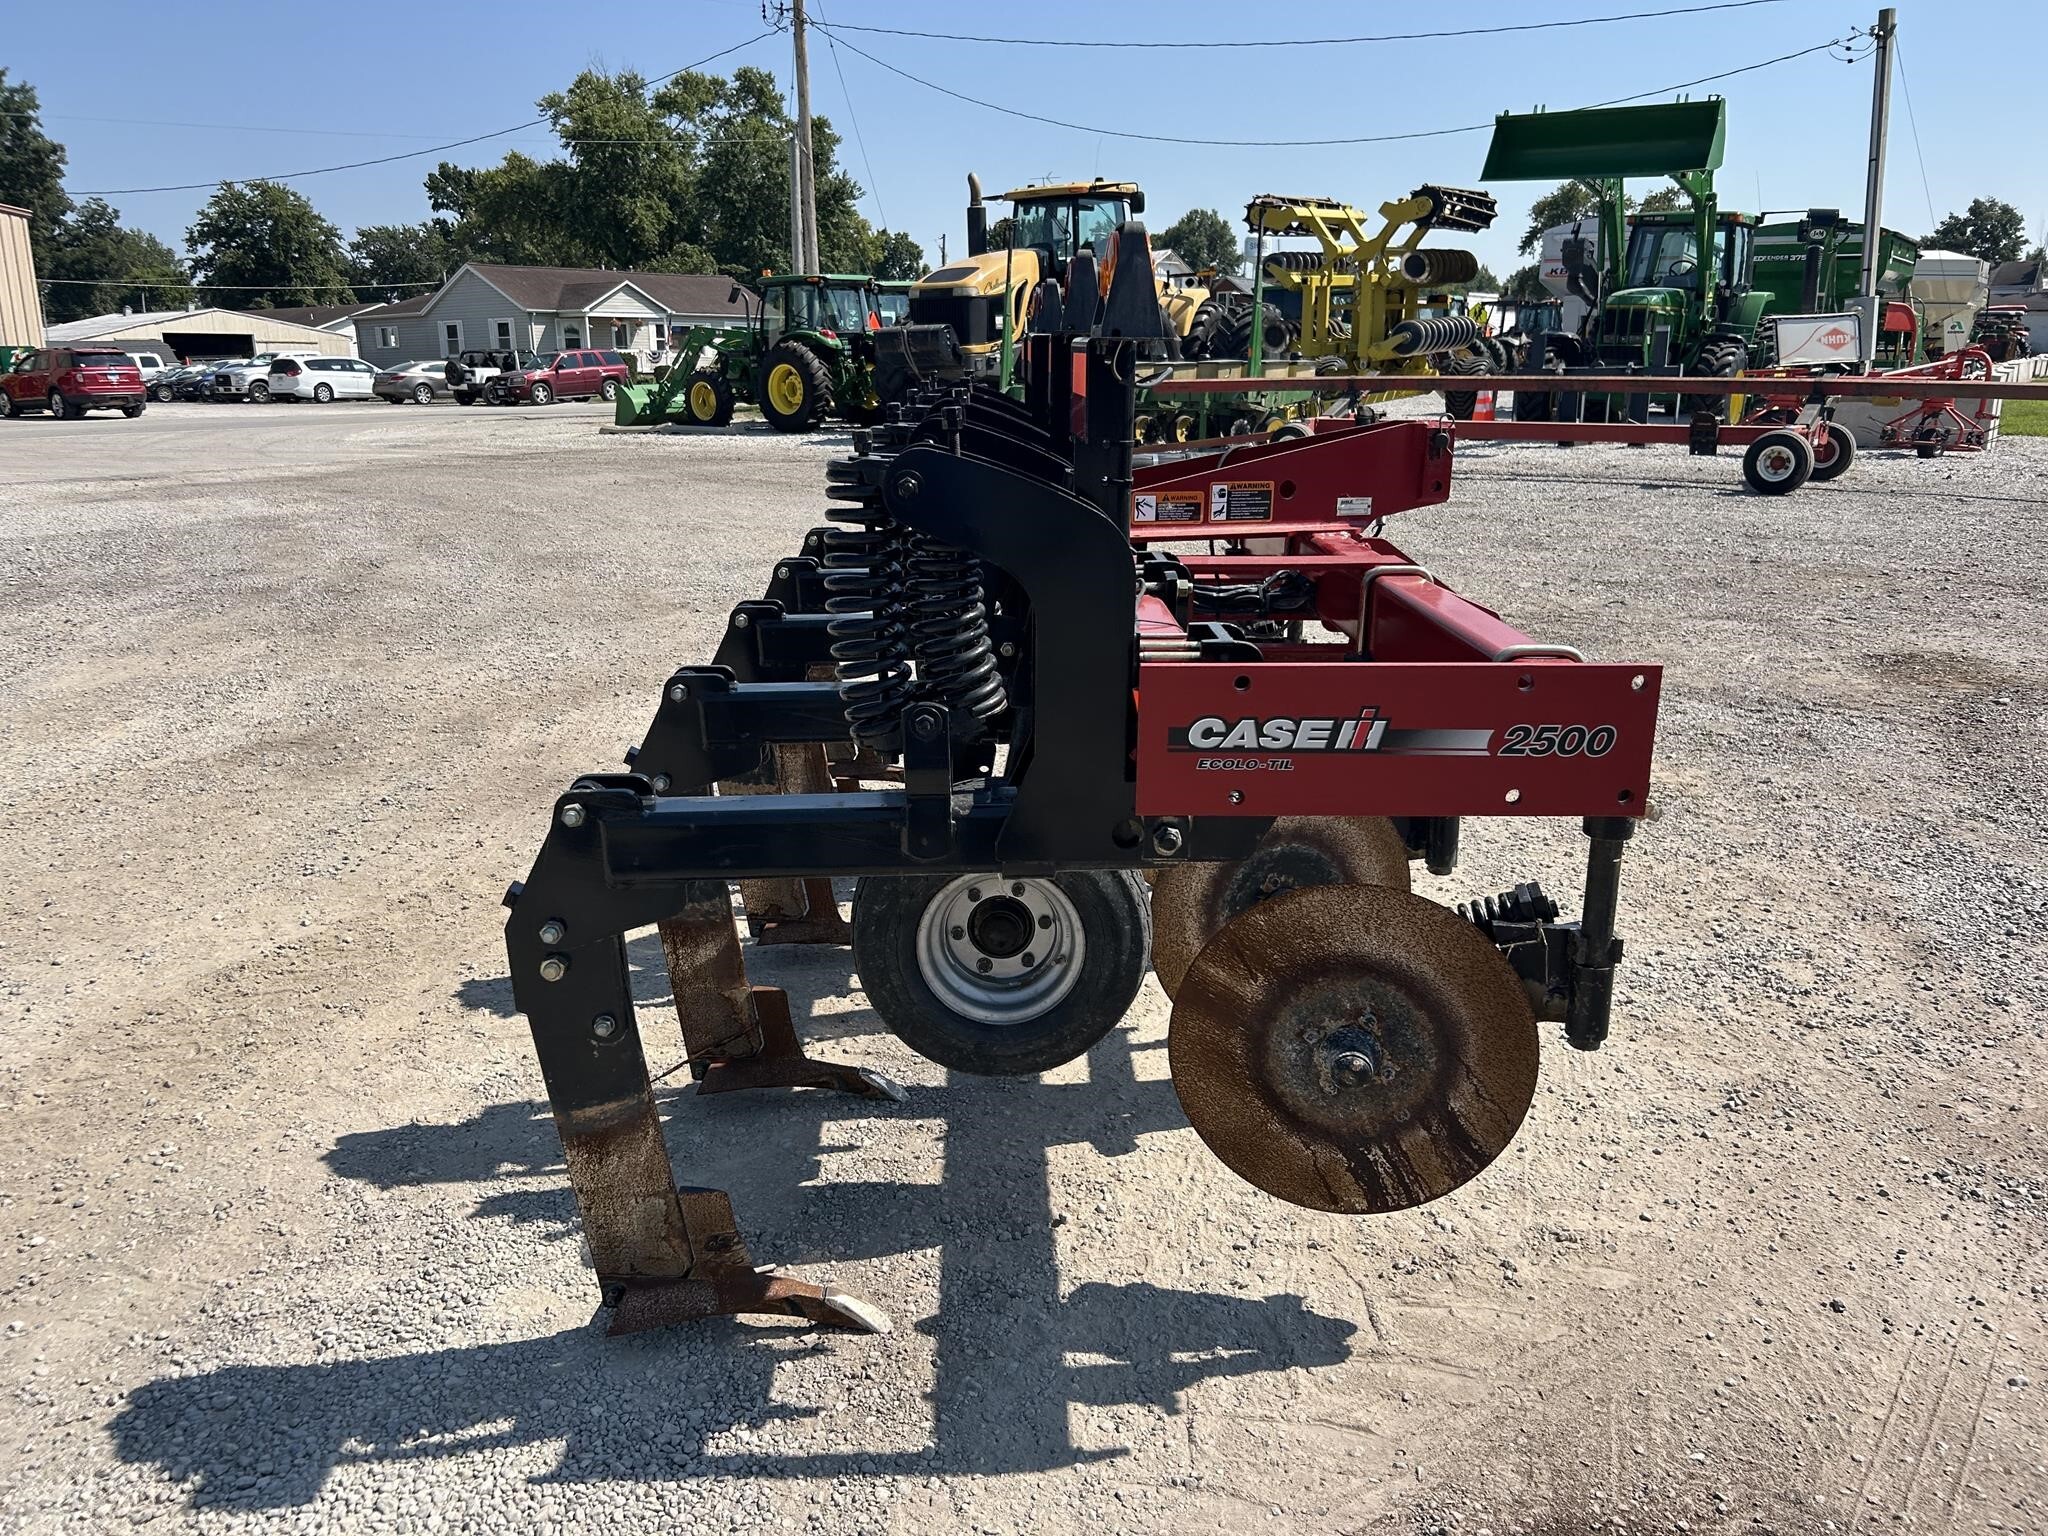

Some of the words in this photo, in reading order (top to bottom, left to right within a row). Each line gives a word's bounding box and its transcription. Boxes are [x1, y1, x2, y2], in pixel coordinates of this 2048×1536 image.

[1820, 334, 1851, 345] KUHN
[1188, 717, 1335, 749] CASE
[1497, 724, 1617, 758] 2500
[1196, 758, 1295, 770] ECOLO-TIL
